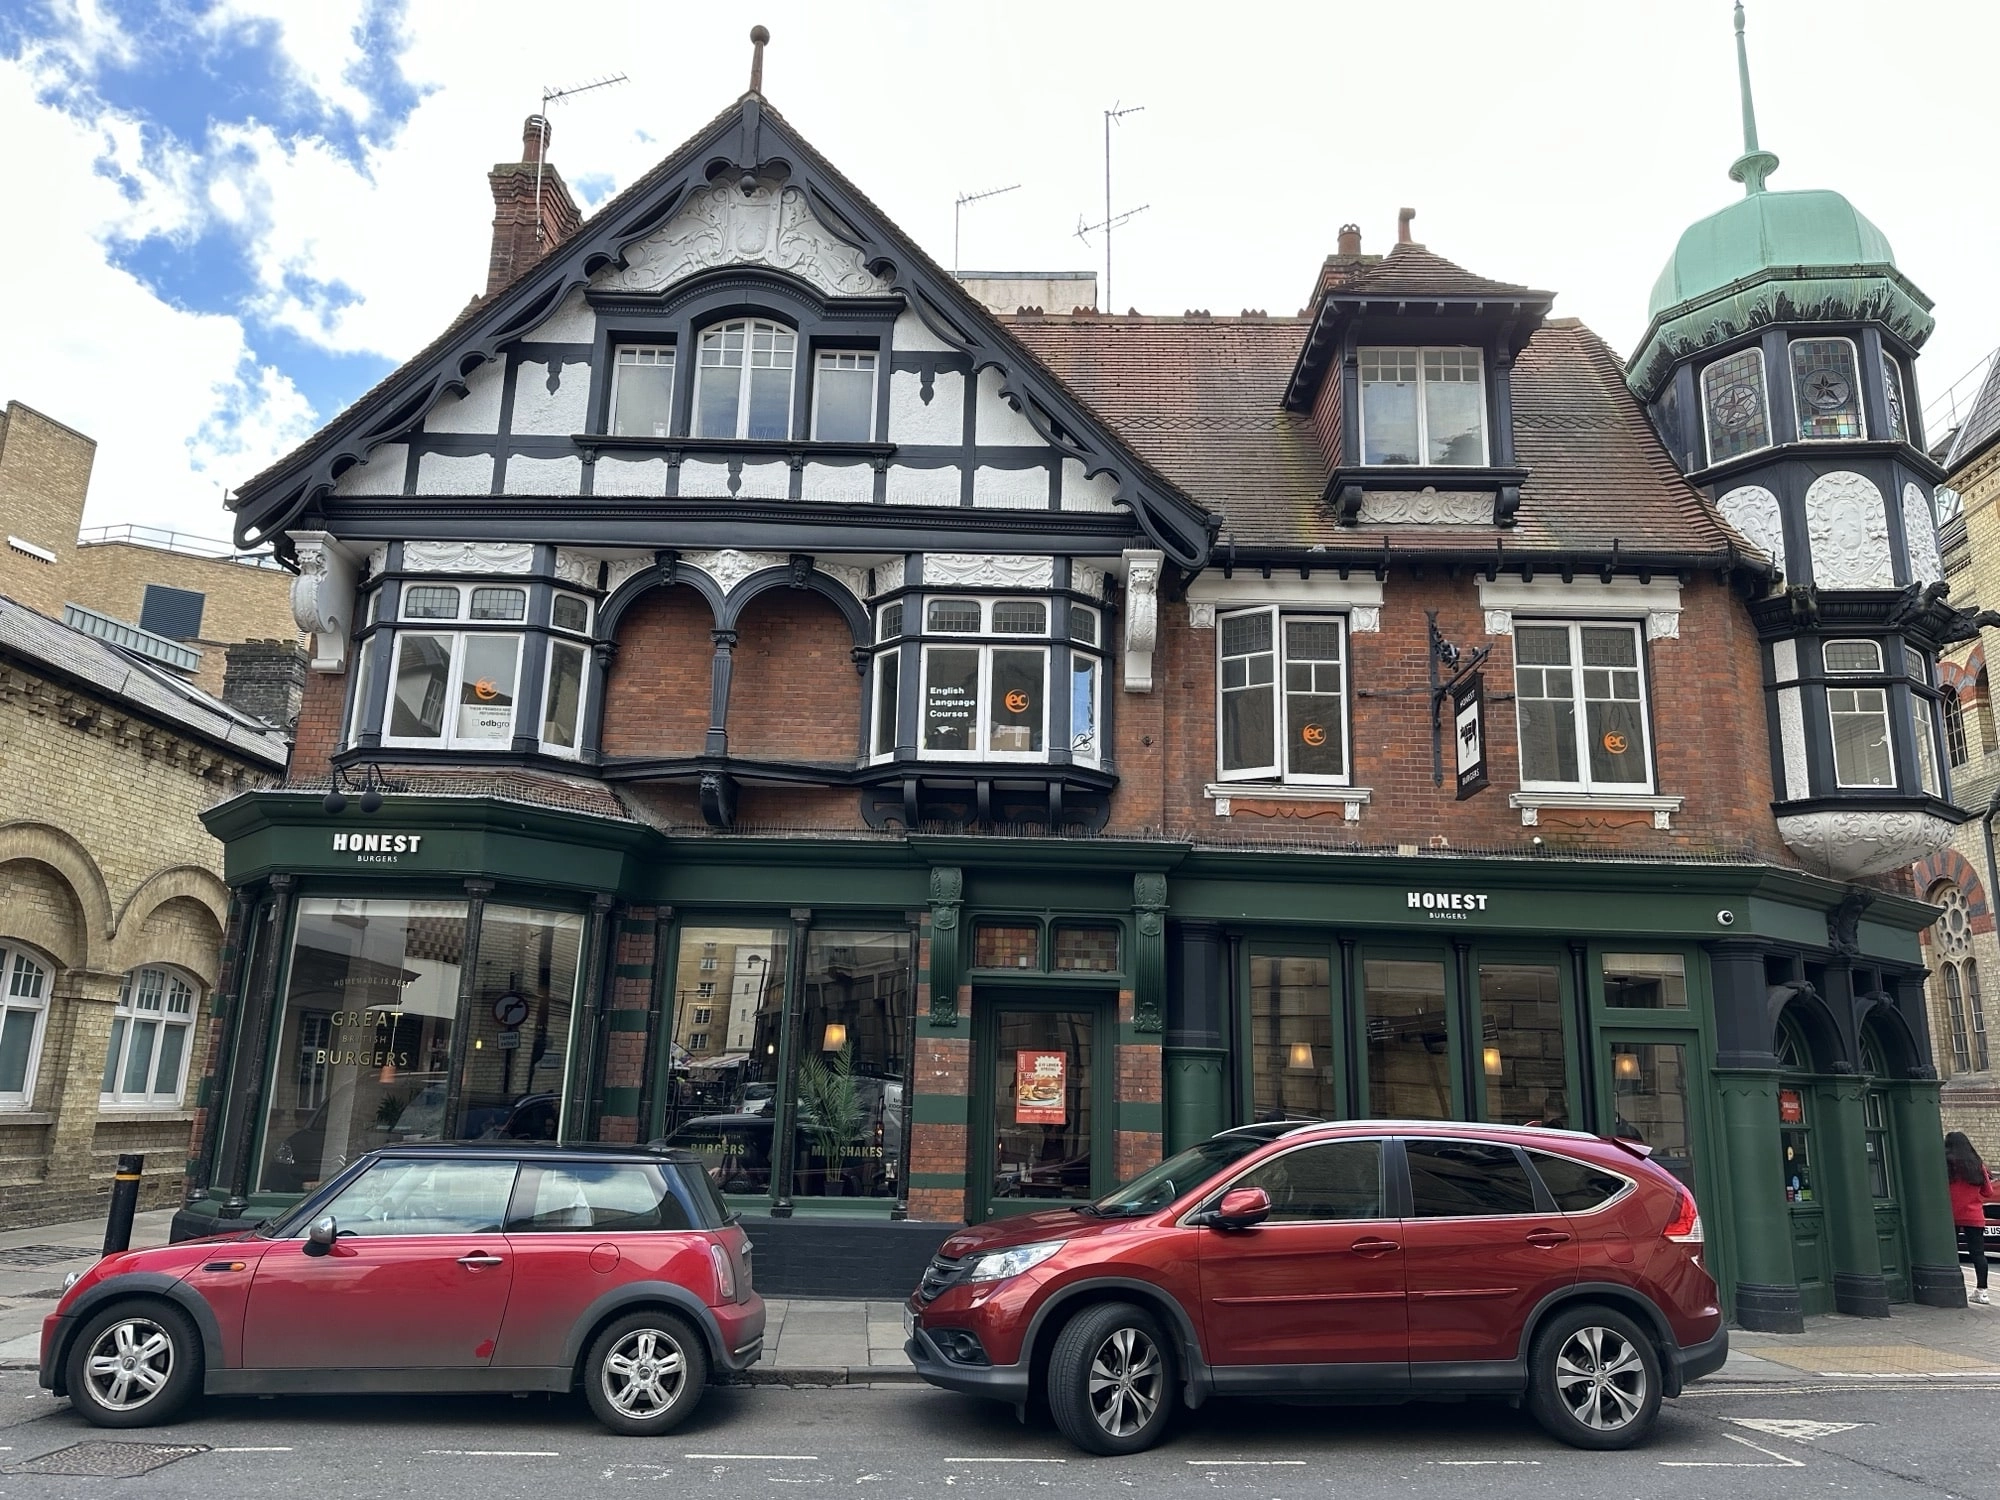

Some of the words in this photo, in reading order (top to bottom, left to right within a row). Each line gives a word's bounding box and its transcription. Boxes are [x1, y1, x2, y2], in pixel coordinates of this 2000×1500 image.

[930, 687, 965, 695] English
[929, 698, 975, 707] Language
[1460, 689, 1475, 708] HONEST
[929, 710, 969, 718] Courses
[1462, 768, 1480, 786] BURGERS
[333, 833, 421, 852] HONEST
[357, 855, 398, 863] BURGERS
[1407, 892, 1488, 910] HONEST
[1429, 912, 1467, 920] BURGERS
[333, 977, 377, 987] HOMEMADE
[381, 977, 389, 985] IS
[391, 978, 411, 989] BEST
[331, 1011, 404, 1028] GREAT
[342, 1034, 387, 1044] BRITISH
[316, 1050, 408, 1066] BURGERS
[690, 1143, 745, 1155] BURGERS
